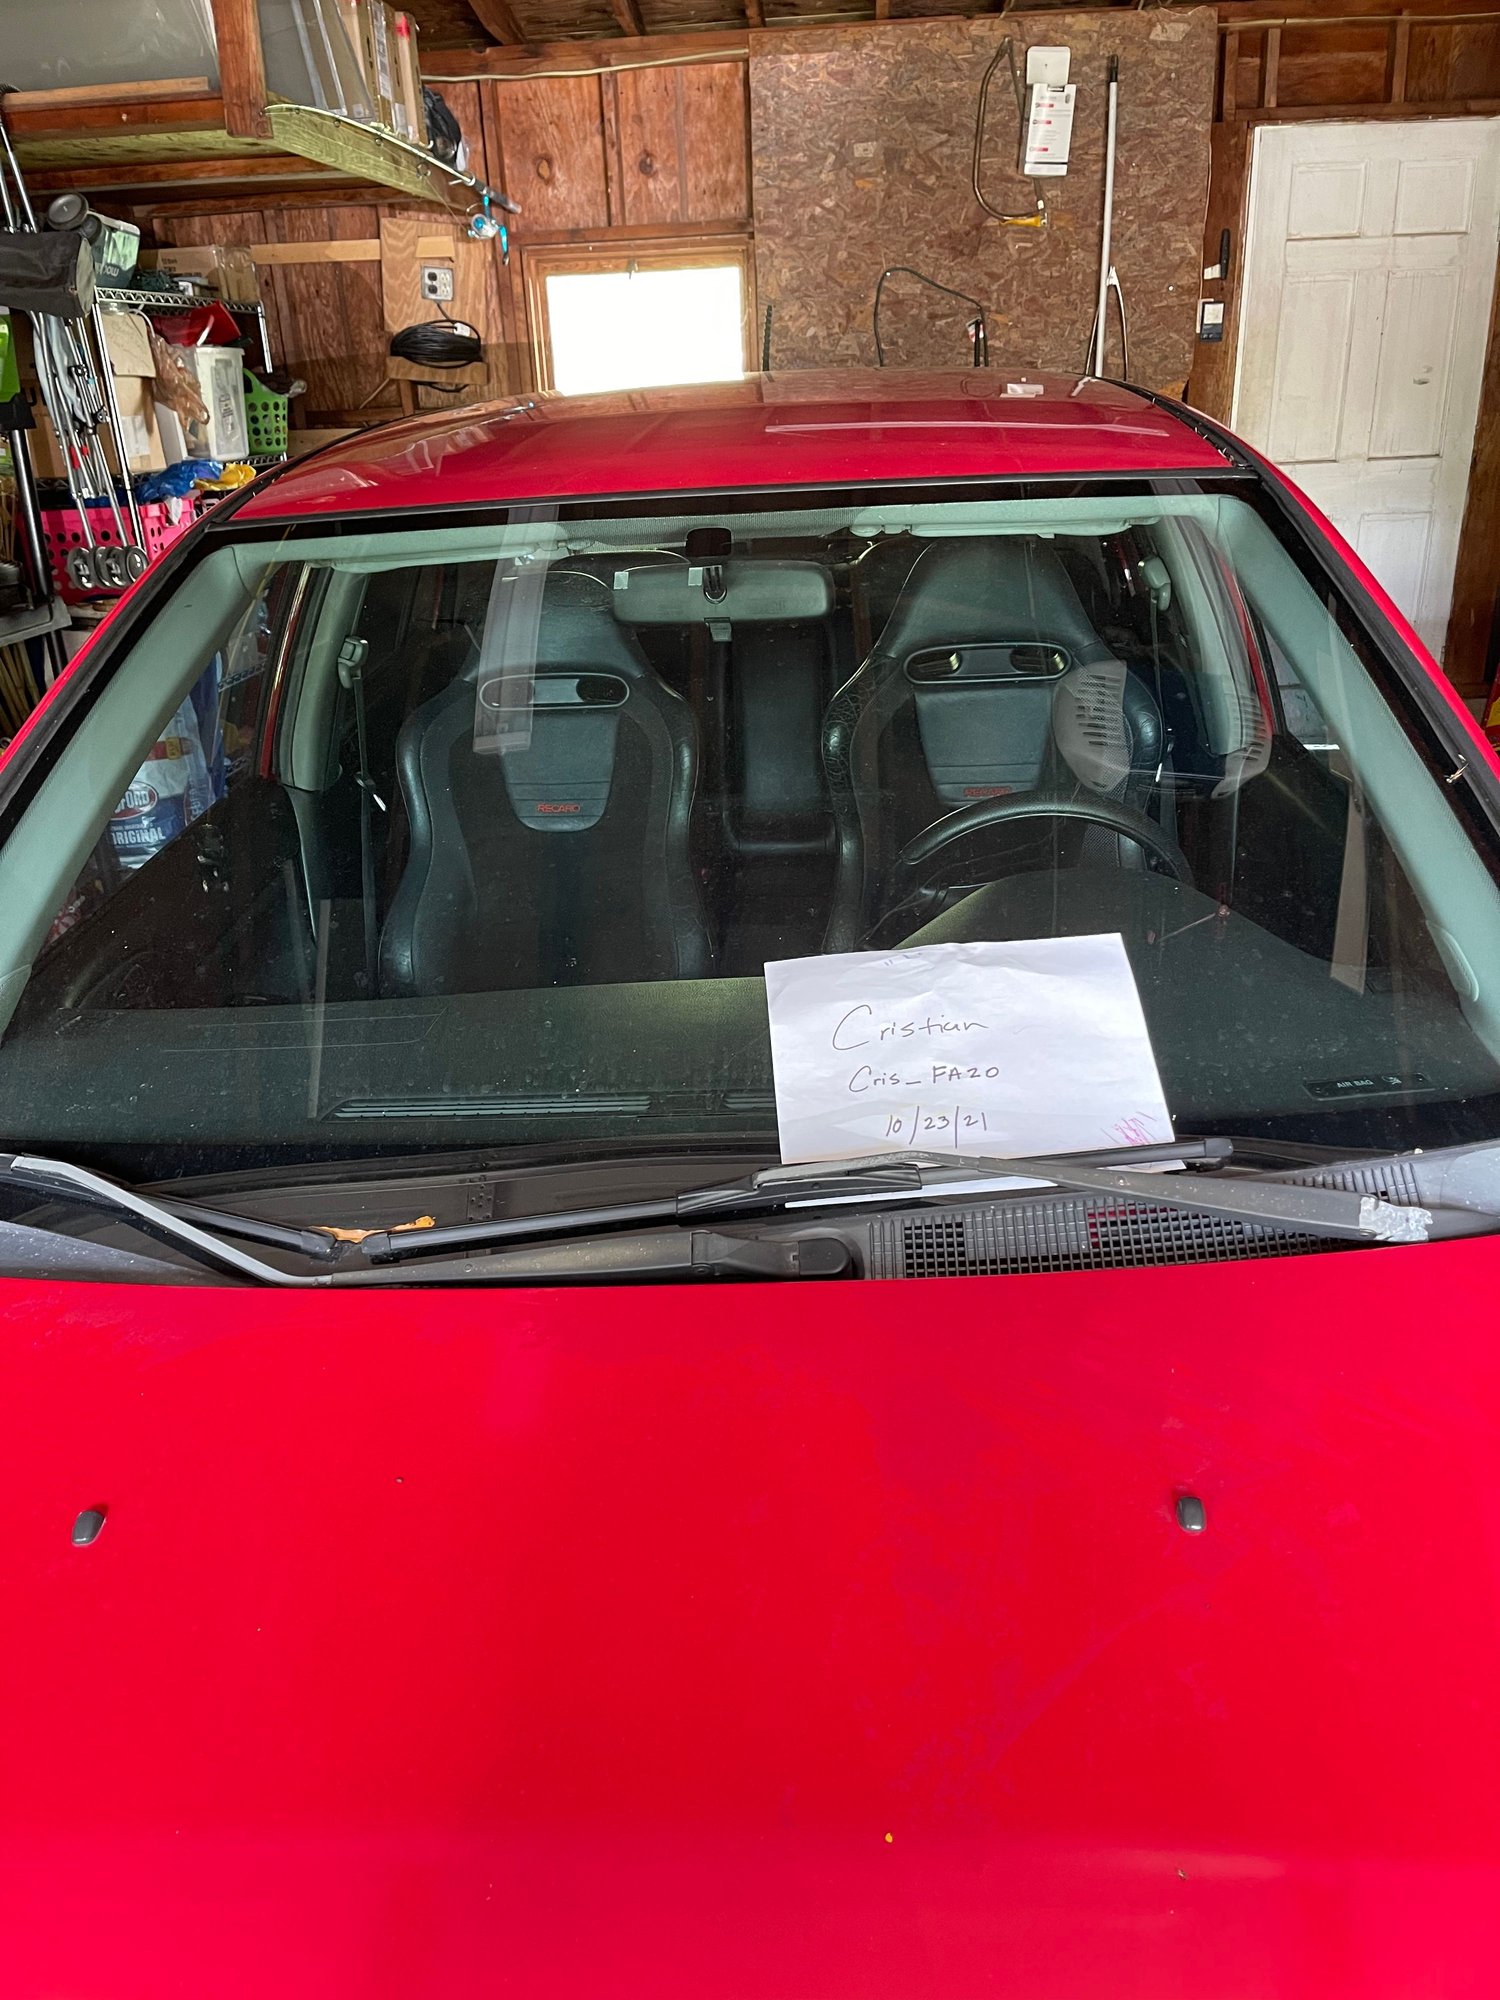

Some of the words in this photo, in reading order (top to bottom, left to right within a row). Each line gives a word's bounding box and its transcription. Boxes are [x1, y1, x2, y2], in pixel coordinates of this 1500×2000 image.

[537, 804, 580, 813] RECARO
[832, 1004, 989, 1050] Cristian
[1354, 1079, 1374, 1087] BAG
[885, 1105, 987, 1149] 10/23/21
